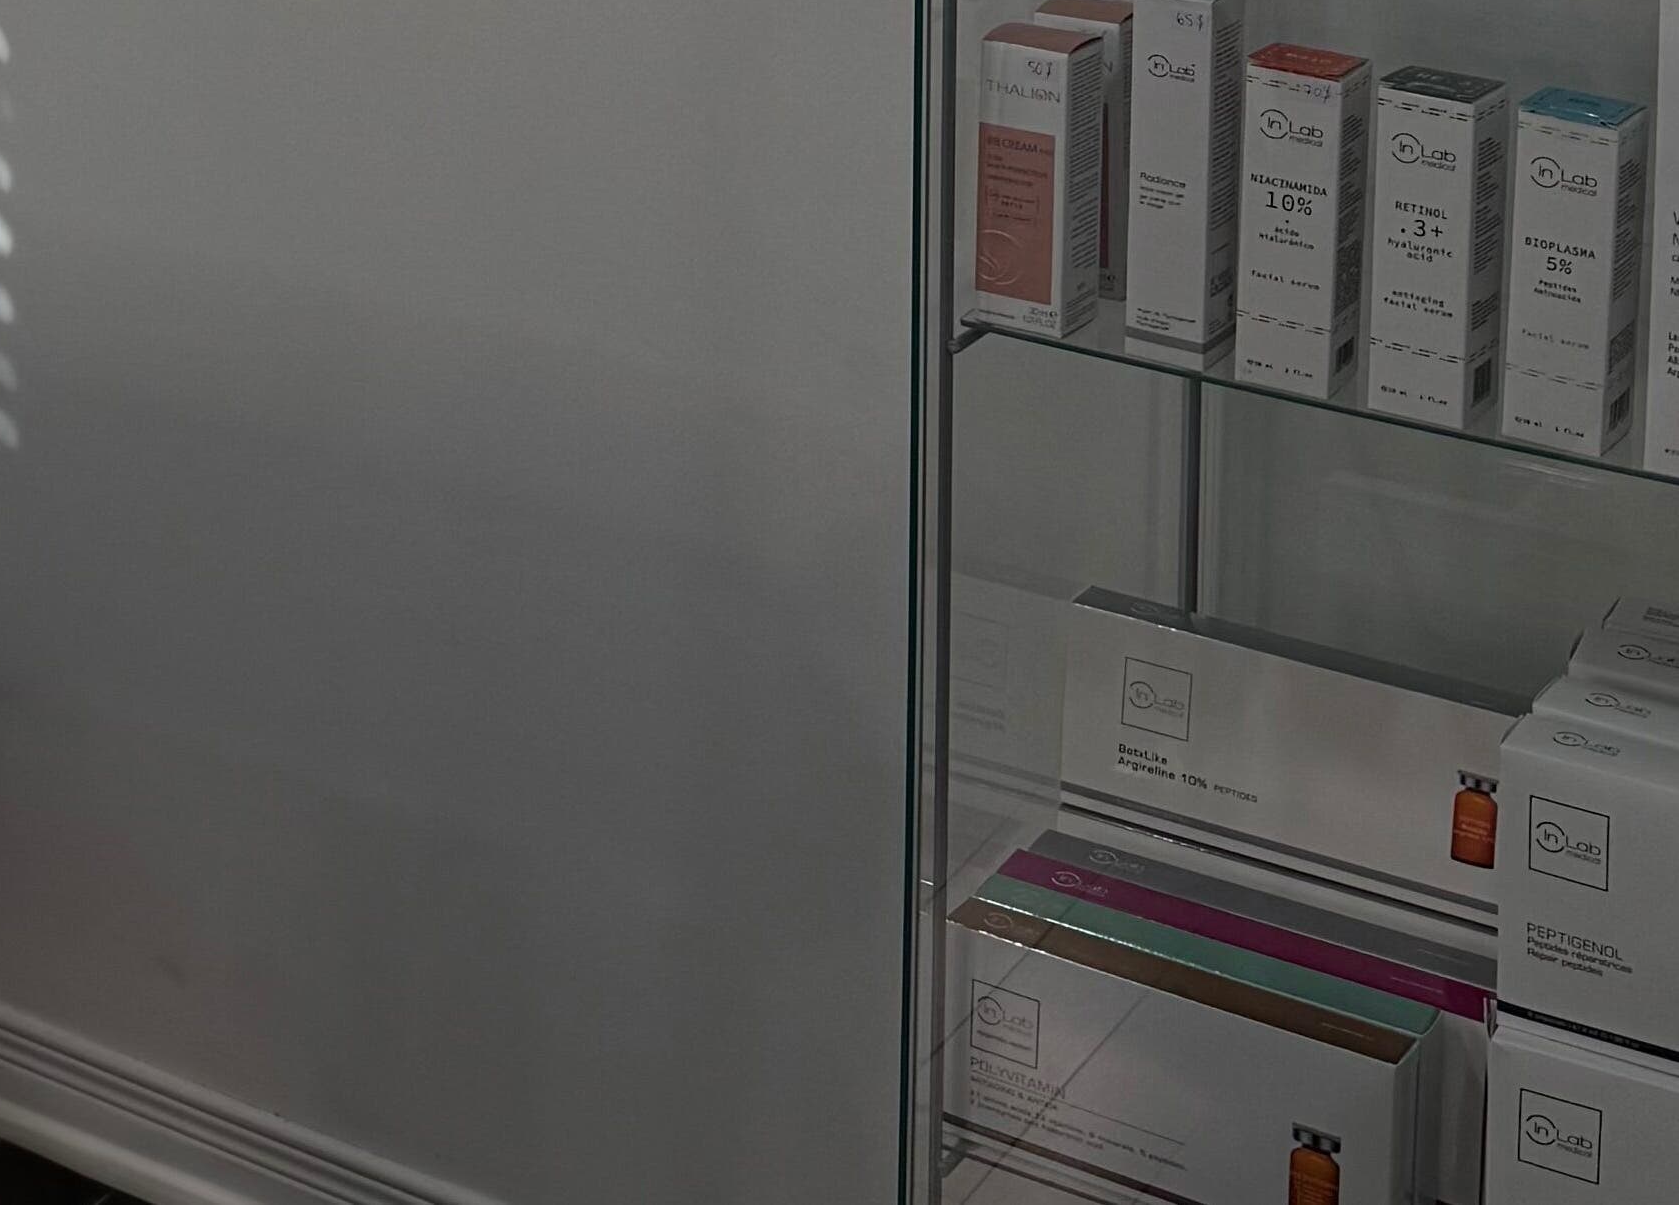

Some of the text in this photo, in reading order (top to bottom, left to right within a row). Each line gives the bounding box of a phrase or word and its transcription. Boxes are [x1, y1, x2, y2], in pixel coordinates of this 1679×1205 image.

[985, 78, 1060, 103] THALION
[1267, 116, 1324, 138] In Lab
[1399, 140, 1456, 163] In Lab
[1140, 172, 1186, 188] Radiance
[1250, 173, 1328, 196] NIACINAMIDA
[1538, 164, 1598, 188] In Lab
[1265, 191, 1312, 216] 10%
[1395, 200, 1447, 220] RETINOL
[1387, 237, 1452, 258] hyaluronic
[1406, 252, 1433, 263] acid
[1525, 236, 1596, 259] BIOPLASMA
[1546, 256, 1572, 275] 5%
[1118, 756, 1257, 802] Argireline 10% PEPTIDES
[1544, 828, 1601, 855] In Lab
[1527, 922, 1623, 961] PEPTIGENOL
[1534, 1121, 1593, 1149] In Lab
